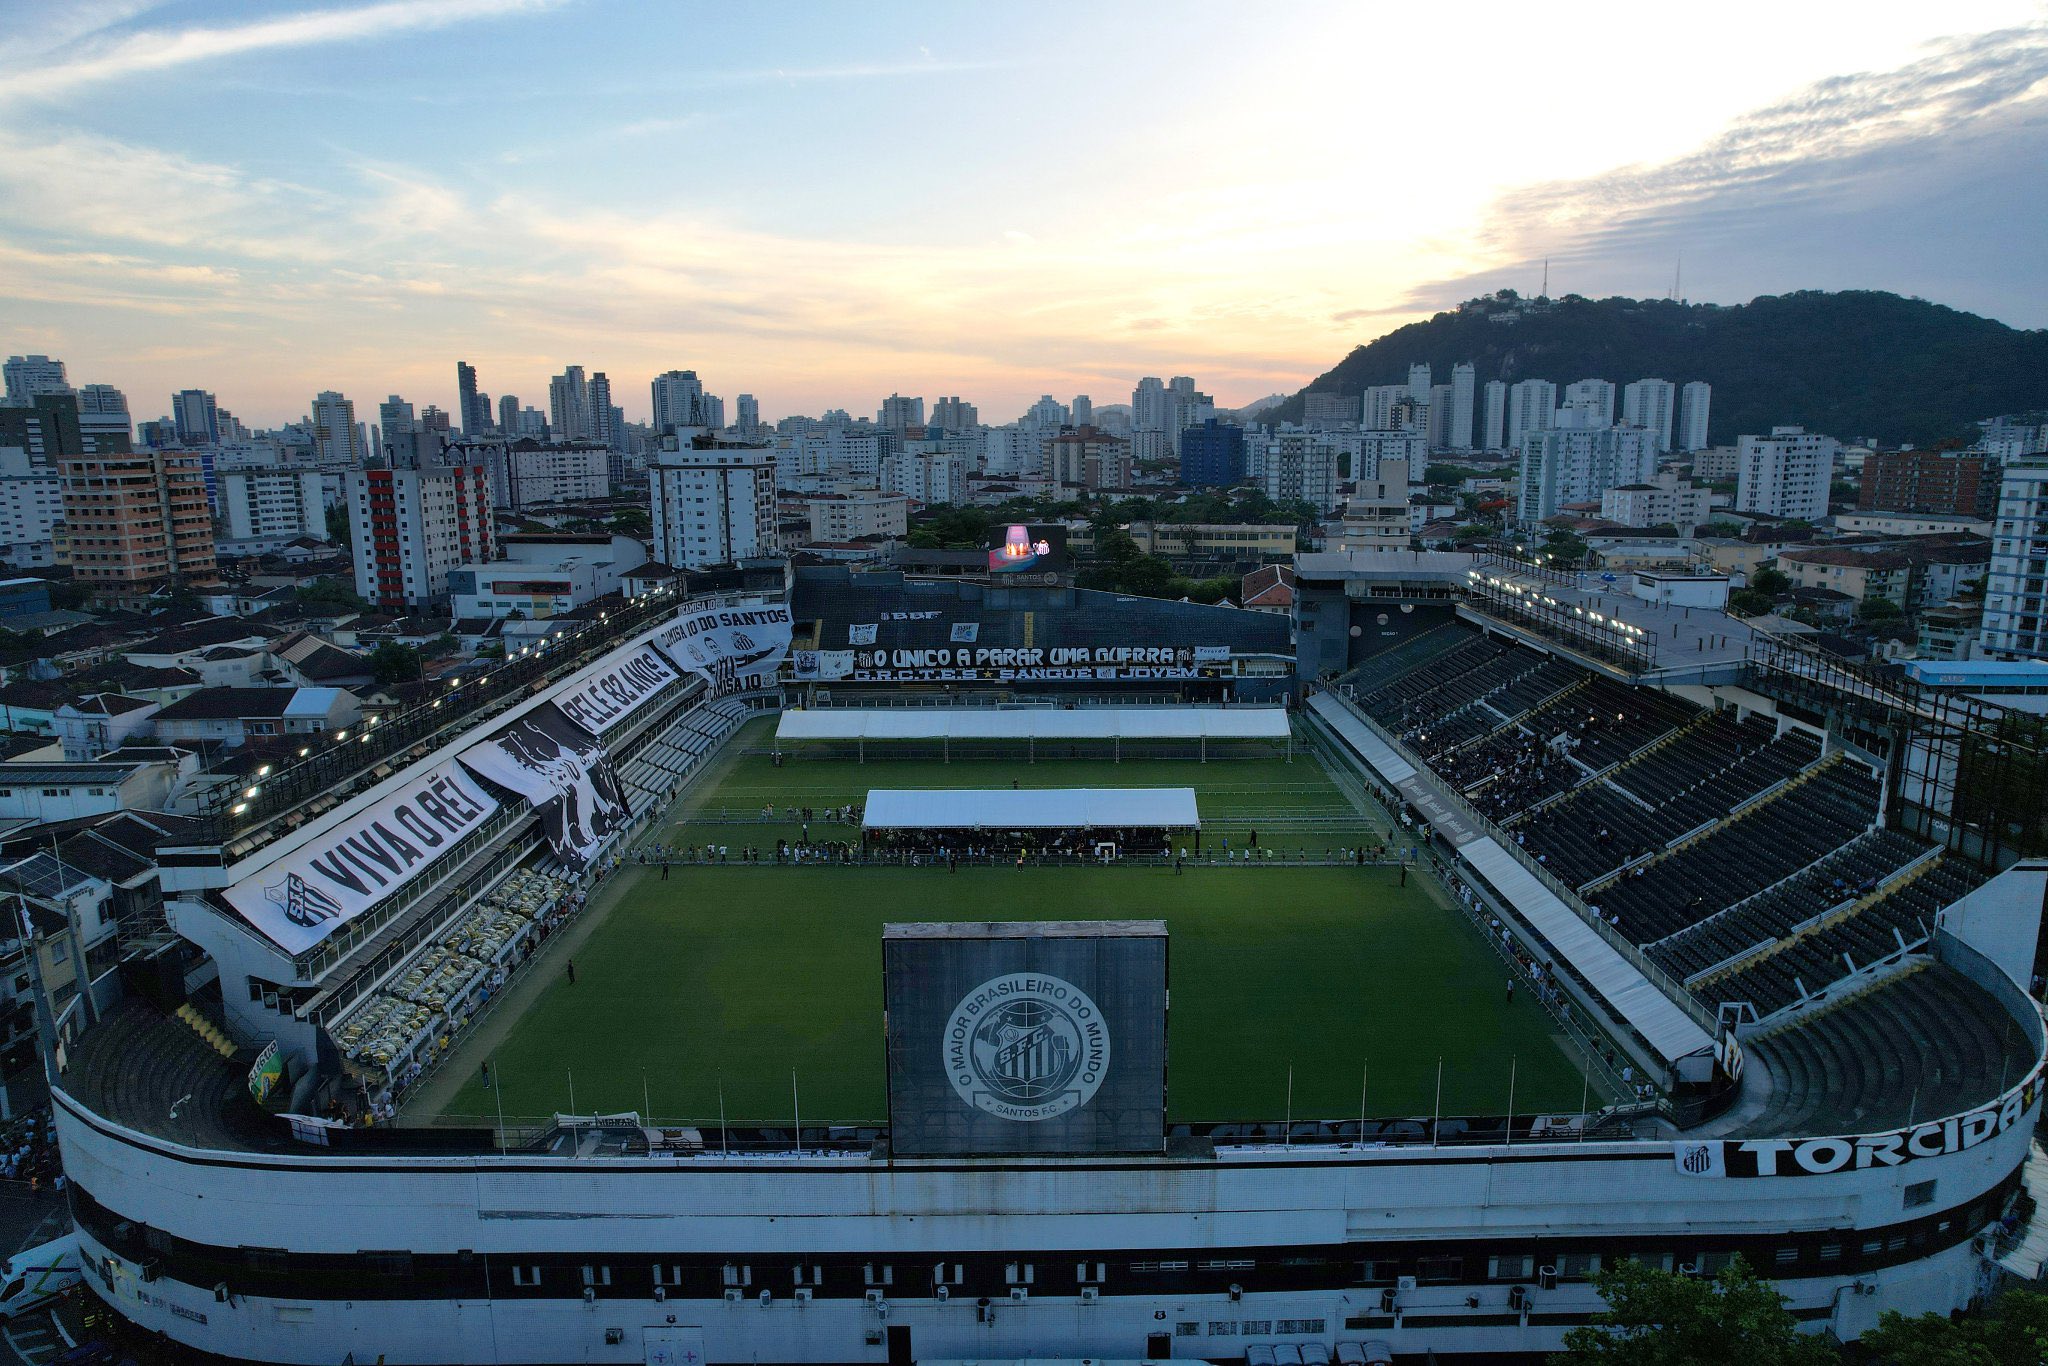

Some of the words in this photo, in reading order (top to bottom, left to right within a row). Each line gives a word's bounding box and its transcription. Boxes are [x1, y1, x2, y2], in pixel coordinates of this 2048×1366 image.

[688, 619, 699, 637] 10
[699, 614, 718, 632] DO
[719, 608, 789, 627] SANTOS
[891, 610, 943, 620] BBF
[874, 649, 887, 667] O
[957, 648, 971, 667] A
[976, 648, 1044, 667] PARAR
[1050, 647, 1090, 665] UMA
[1000, 668, 1092, 679] SANGUE
[1119, 667, 1199, 679] JOVEM
[745, 673, 763, 691] 10
[561, 679, 622, 732] PELÉ
[600, 674, 639, 706] 82
[415, 776, 485, 834] REI
[394, 804, 445, 848] O
[309, 821, 425, 896] VIVA
[966, 979, 1068, 1016] BRASILEIRO
[1067, 996, 1091, 1020] DO
[950, 1016, 971, 1071] MAIOR
[1083, 1021, 1104, 1084] MUNDO
[958, 1074, 972, 1086] O
[995, 1104, 1039, 1118] SANTOS
[1738, 1089, 2025, 1176] TORCIDA
